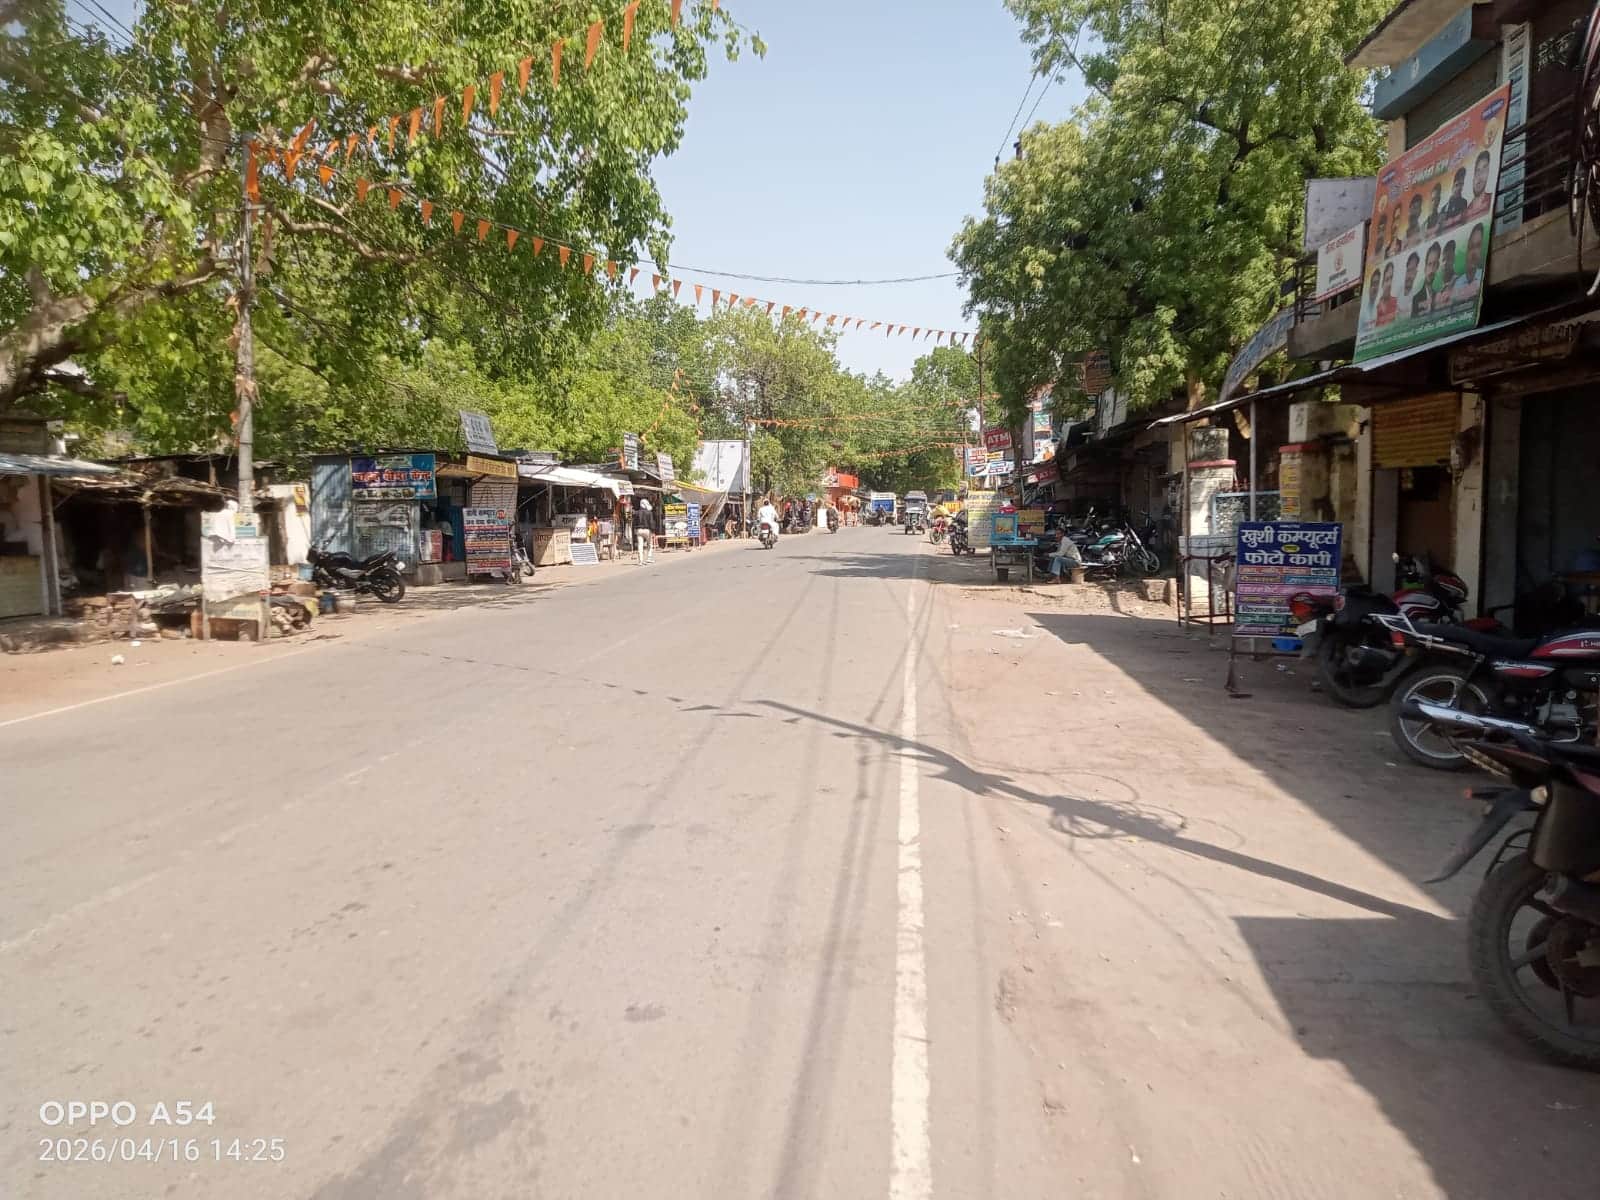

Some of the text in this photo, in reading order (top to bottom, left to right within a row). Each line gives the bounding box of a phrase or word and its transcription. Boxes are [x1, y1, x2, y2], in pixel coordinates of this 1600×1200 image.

[987, 433, 1009, 443] ATM
[1240, 526, 1340, 549] खुशी कम्प्यूटर्स
[1245, 549, 1332, 566] फोटो कापी
